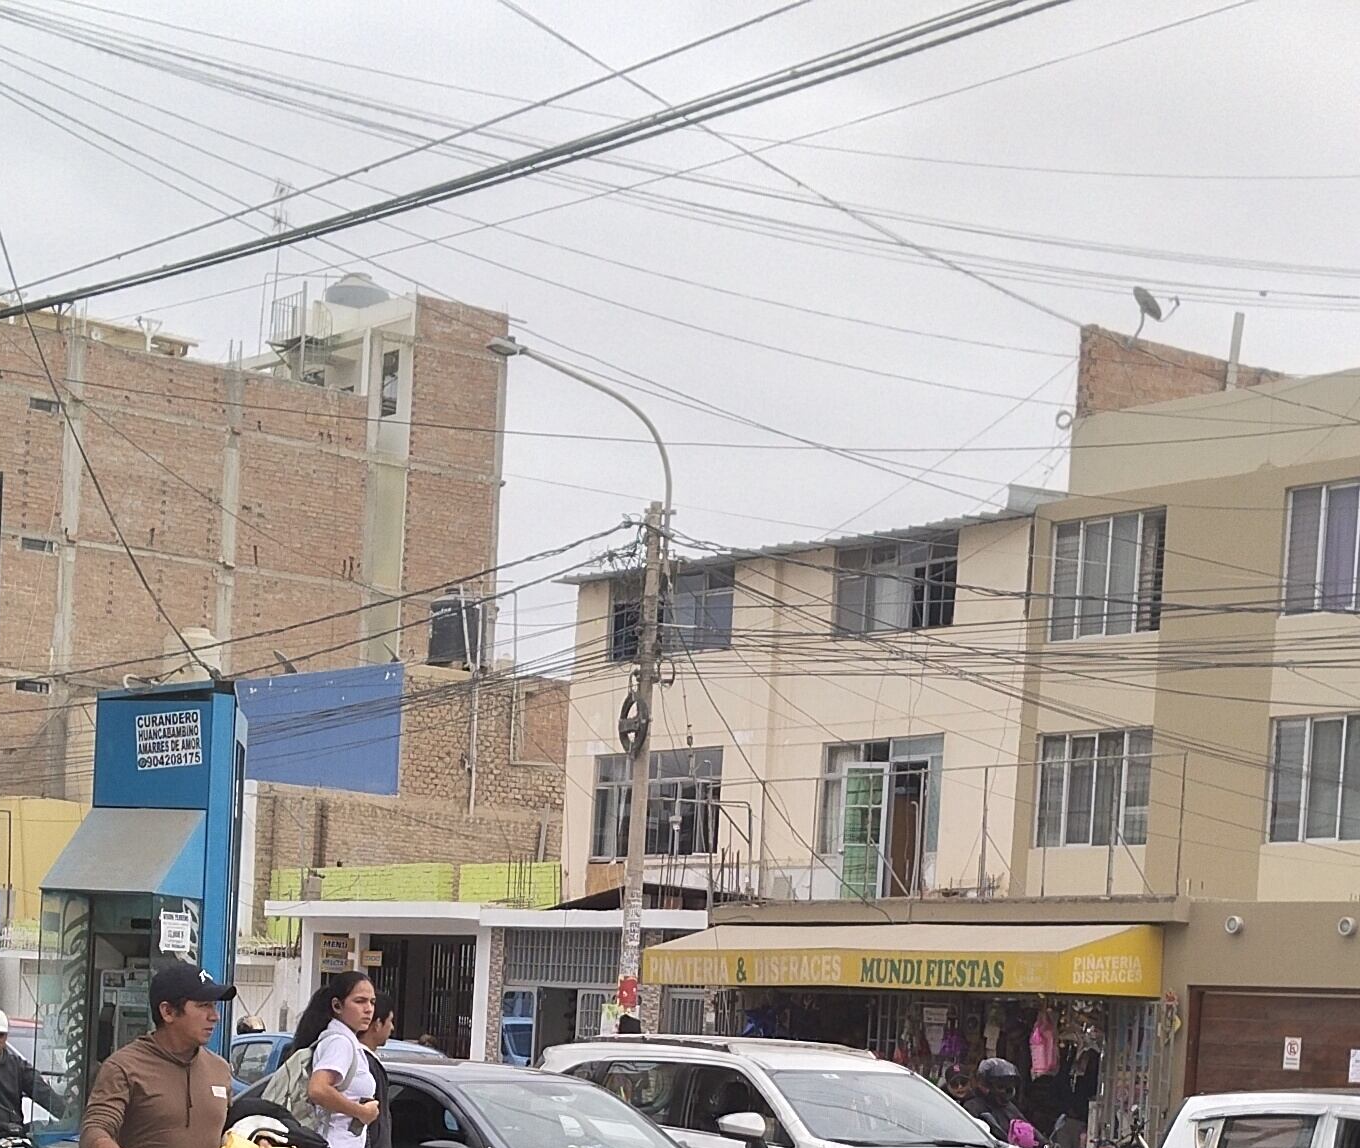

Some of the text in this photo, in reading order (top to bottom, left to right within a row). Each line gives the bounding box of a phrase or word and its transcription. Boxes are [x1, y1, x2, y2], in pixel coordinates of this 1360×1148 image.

[137, 711, 199, 729] CURANDERO
[138, 725, 199, 742] HUANCABAMBINO
[138, 737, 202, 755] AMARRES DE AMOR
[736, 956, 747, 982] &
[754, 954, 841, 983] DISFRACES
[1072, 968, 1143, 984] DISFRACES
